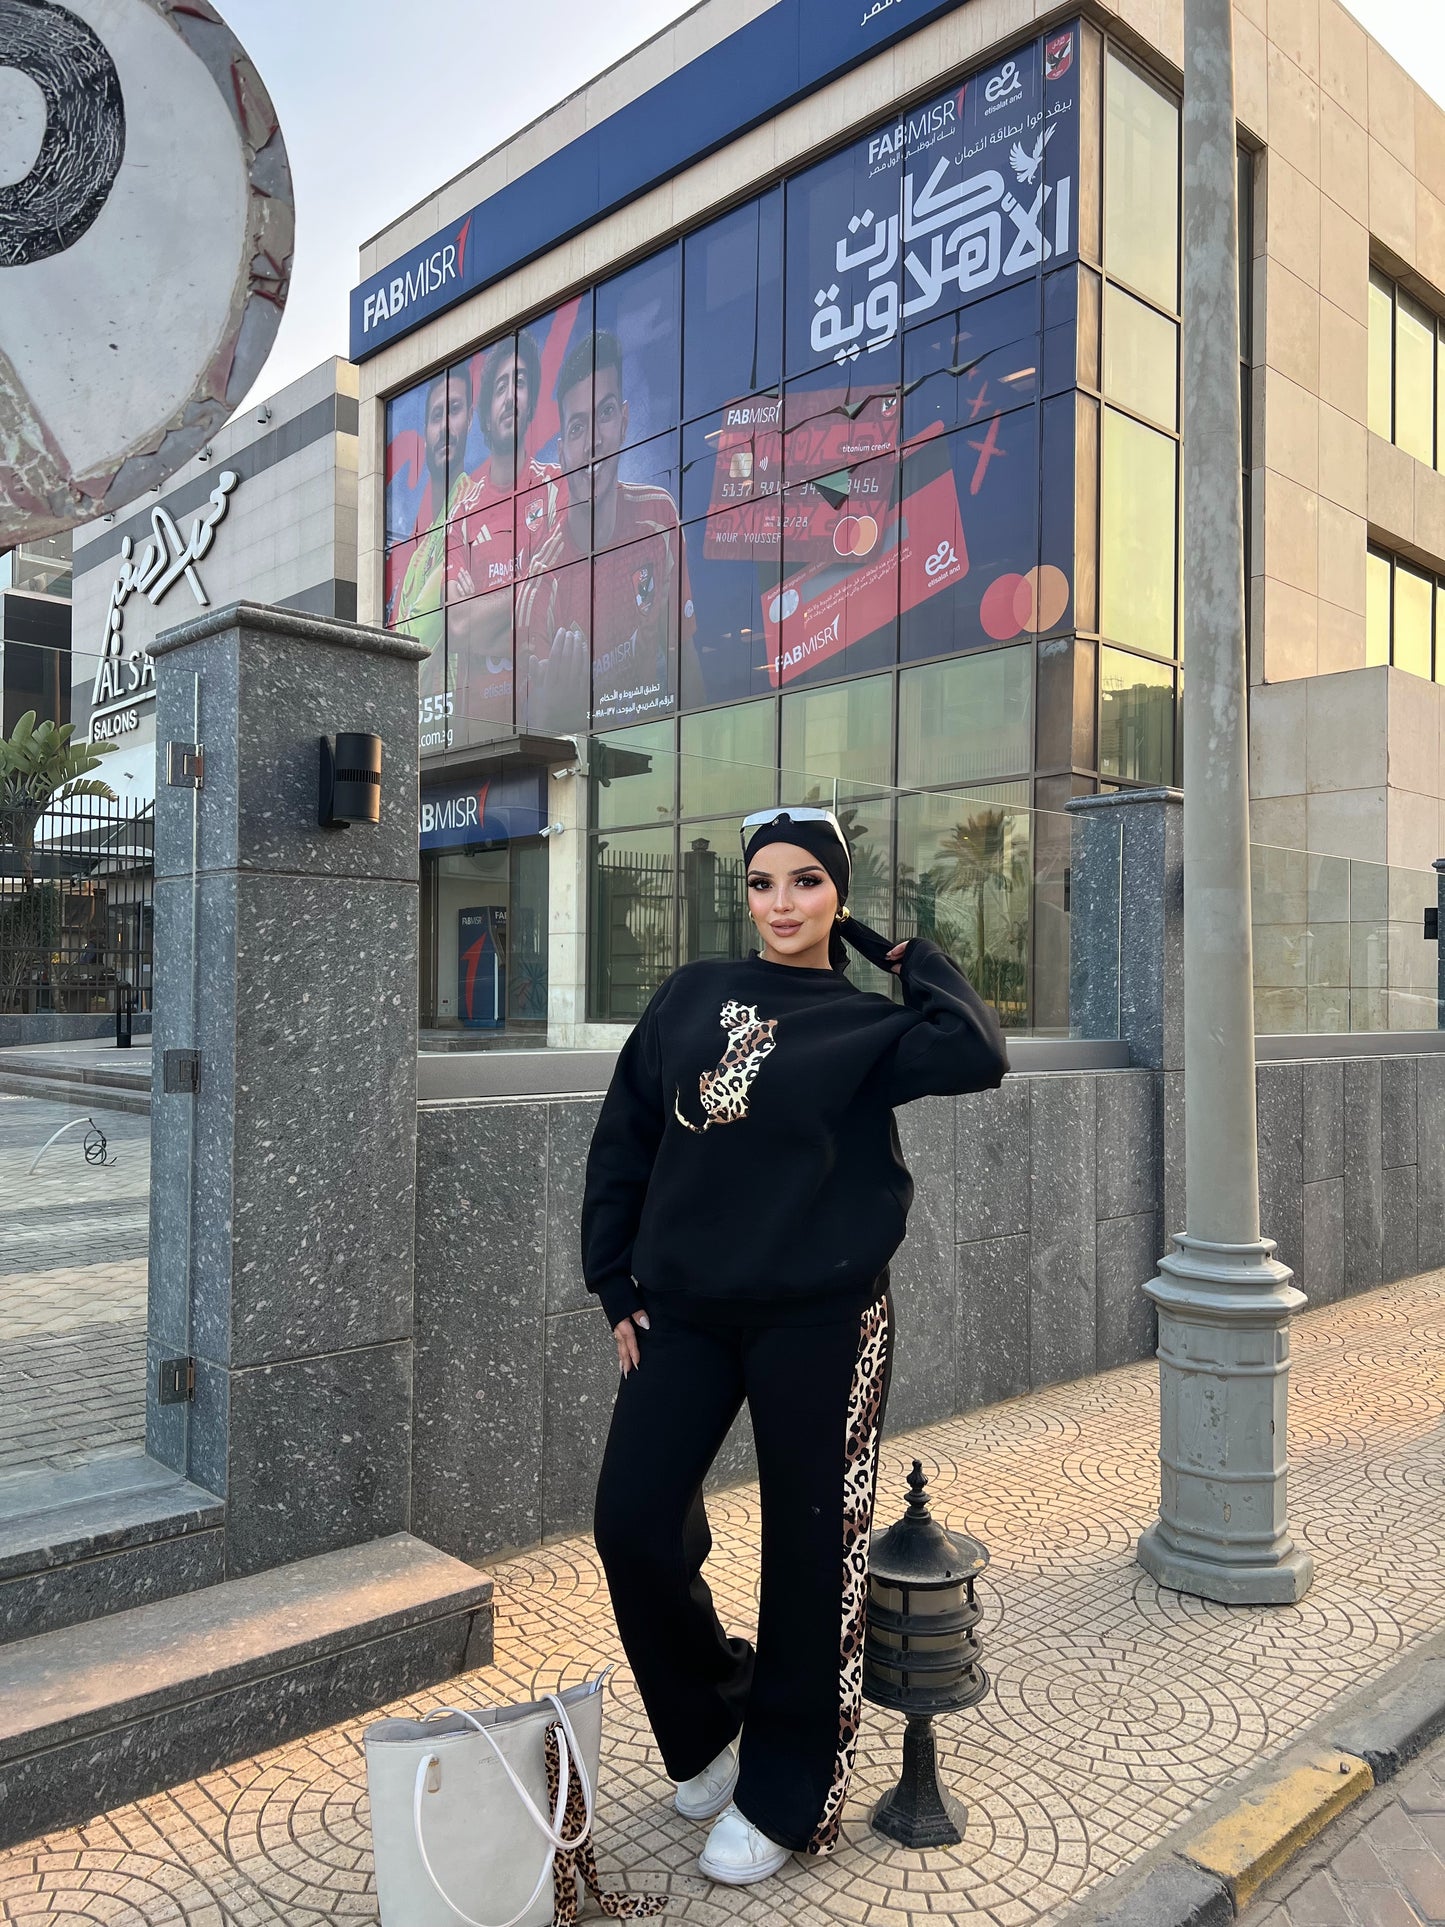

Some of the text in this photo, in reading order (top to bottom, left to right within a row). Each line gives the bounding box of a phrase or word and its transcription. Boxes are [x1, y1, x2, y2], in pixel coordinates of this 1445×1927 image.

[984, 91, 1023, 116] etisalat and
[868, 99, 955, 165] FABMISR
[989, 122, 1024, 145] بطاقة
[868, 163, 887, 179] مصر
[363, 244, 456, 333] FABMISR
[727, 407, 777, 426] FABMISR
[842, 443, 870, 453] titanium
[777, 516, 808, 528] 12/28
[716, 532, 782, 544] NOUR YOUSSEF
[927, 563, 961, 588] etisalat and
[774, 628, 834, 673] FABMISR
[128, 650, 157, 691] SA
[94, 709, 138, 741] SALONS
[419, 795, 478, 833] BMISR
